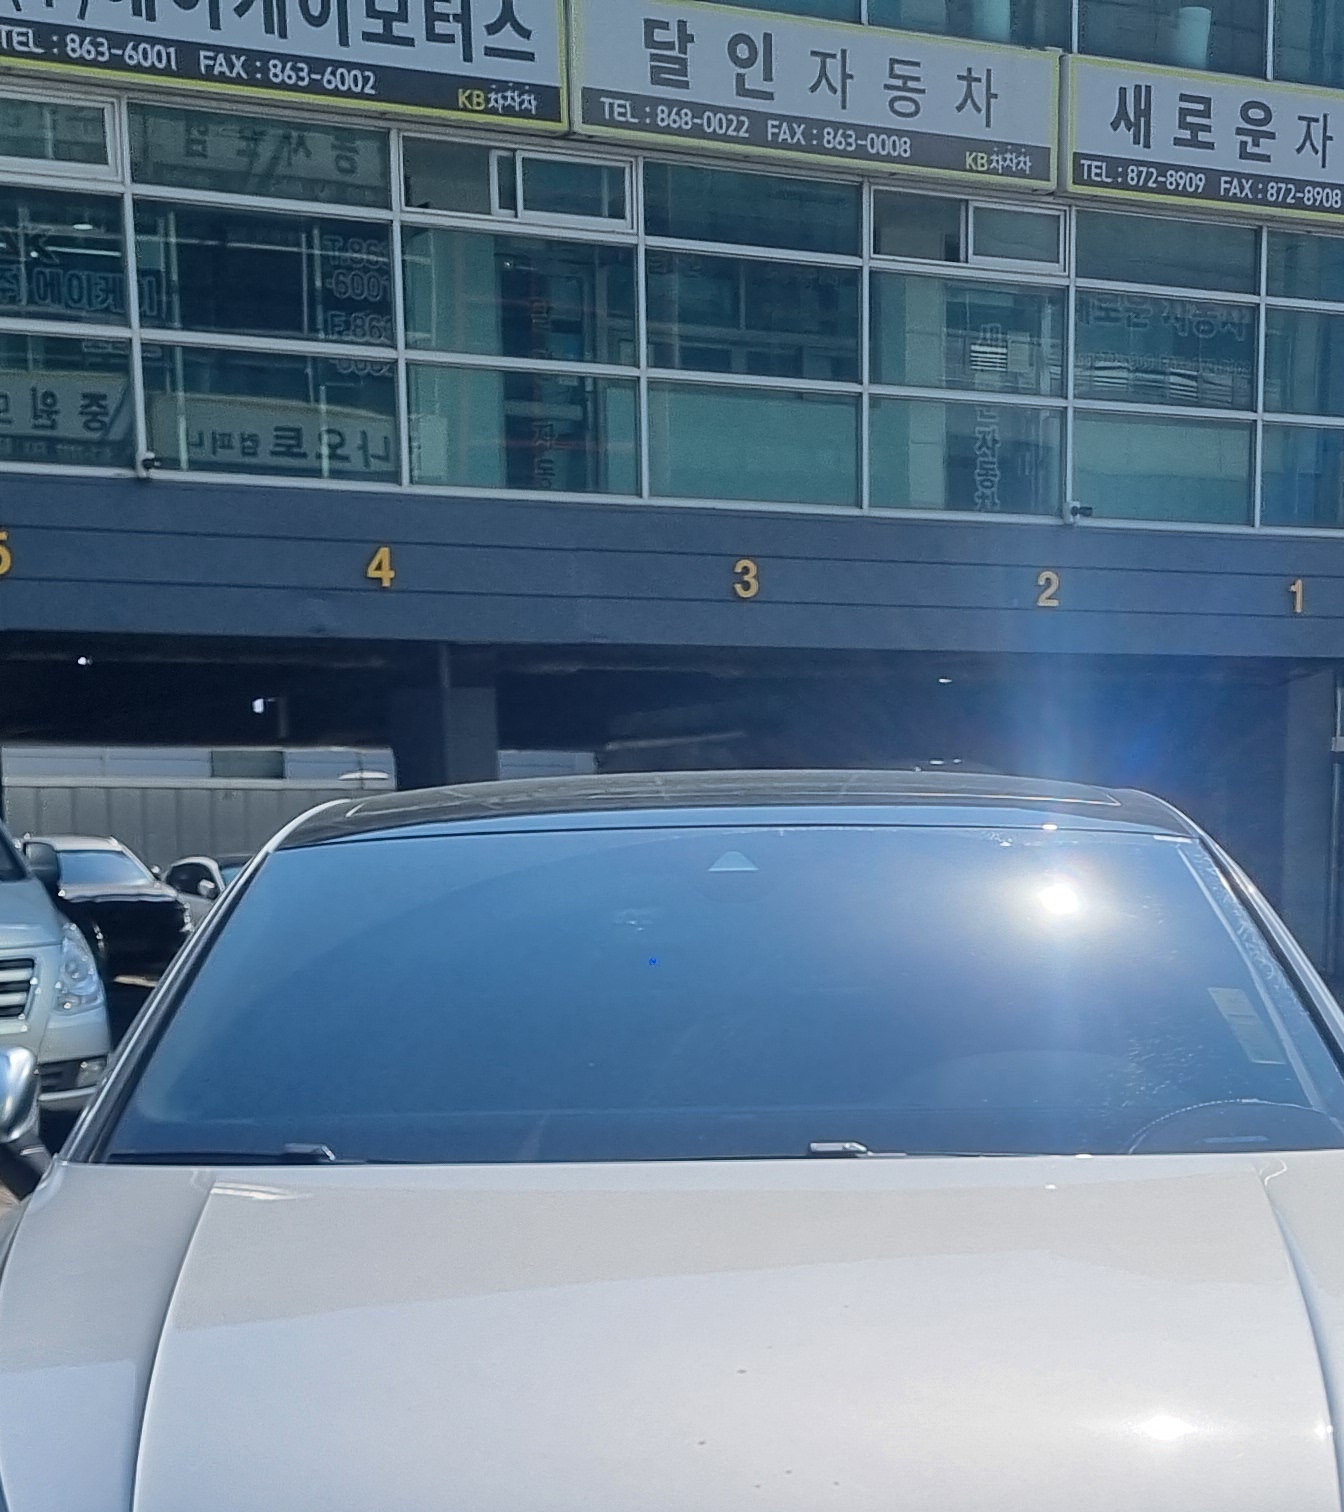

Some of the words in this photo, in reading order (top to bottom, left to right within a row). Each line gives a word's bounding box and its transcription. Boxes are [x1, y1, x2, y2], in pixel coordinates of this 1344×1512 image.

[66, 33, 178, 71] 863-6001
[268, 59, 378, 95] 863-6002
[657, 105, 750, 138] 868-0022
[823, 127, 911, 158] 863-0008
[1127, 165, 1206, 193] 872-8909
[1267, 181, 1343, 209] 872-8908
[366, 546, 395, 587] 4
[732, 559, 760, 599] 3
[1036, 571, 1060, 608] 2
[1288, 579, 1304, 613] 1
